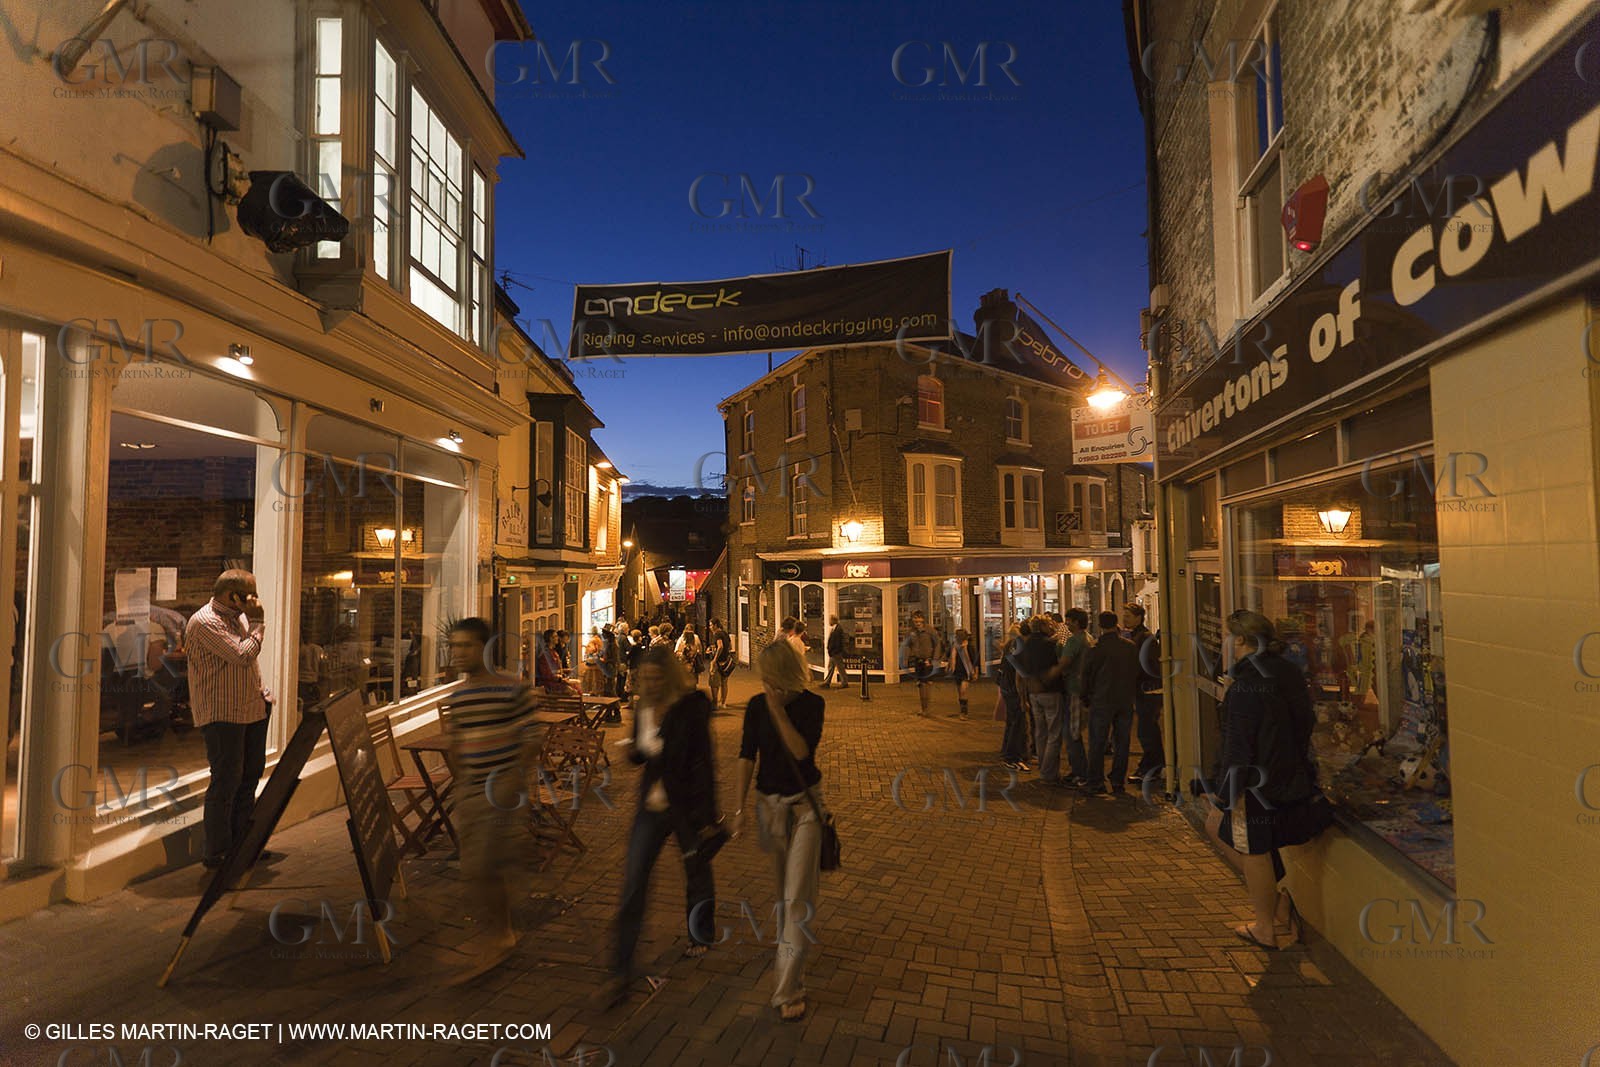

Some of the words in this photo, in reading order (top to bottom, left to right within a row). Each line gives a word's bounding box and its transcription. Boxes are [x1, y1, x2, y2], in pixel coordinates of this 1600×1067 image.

[584, 287, 743, 318] ondeck
[583, 332, 636, 348] Rigging
[641, 330, 705, 346] Services
[723, 312, 937, 343] info@ondeckrigging.com
[1167, 344, 1289, 453] chivertons
[1308, 278, 1361, 363] of
[1085, 423, 1099, 436] TO
[1101, 420, 1121, 433] LET
[1091, 443, 1125, 452] Enquiries
[847, 565, 871, 578] FOX
